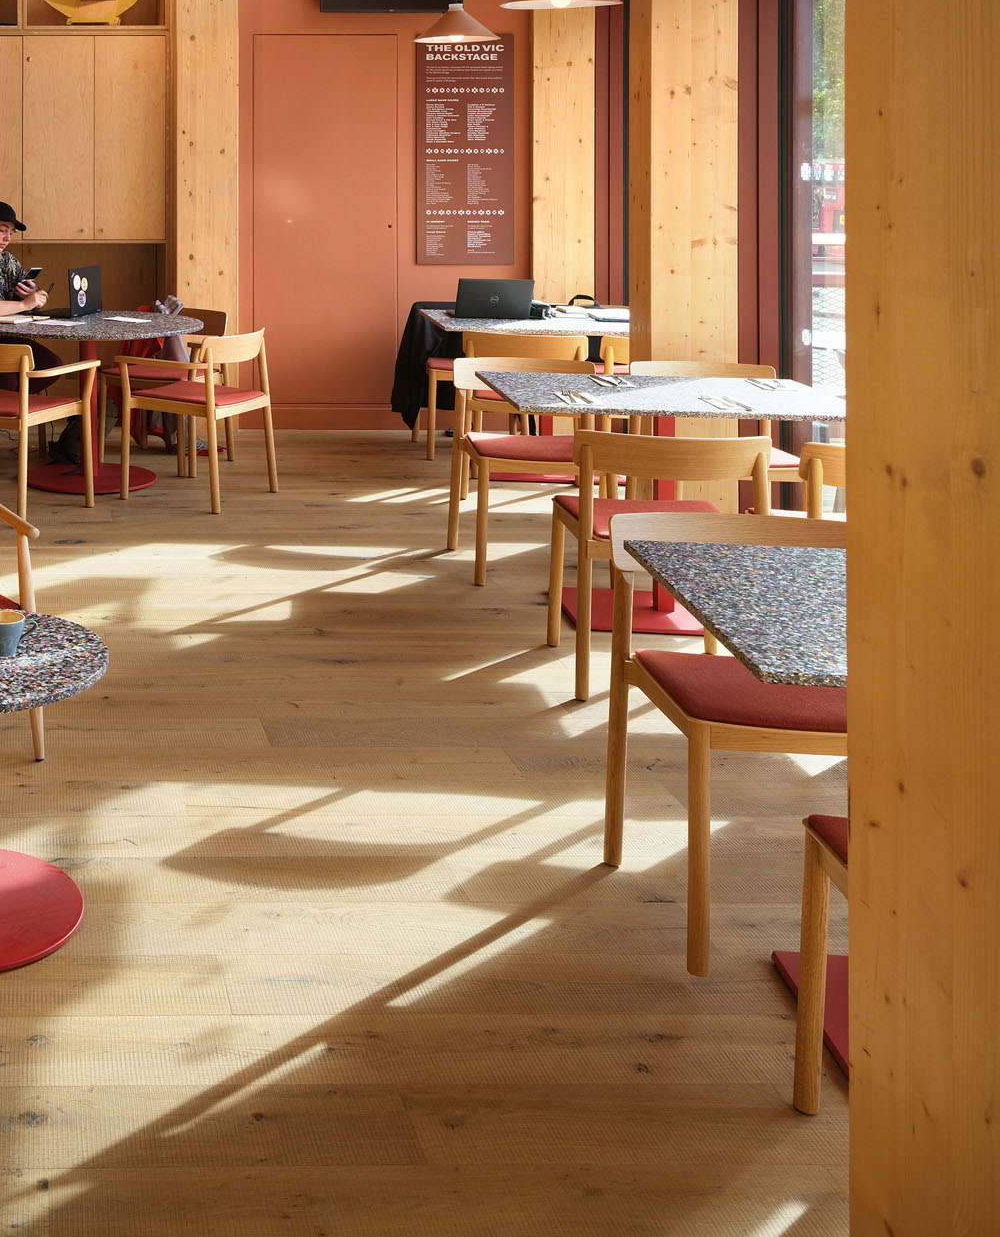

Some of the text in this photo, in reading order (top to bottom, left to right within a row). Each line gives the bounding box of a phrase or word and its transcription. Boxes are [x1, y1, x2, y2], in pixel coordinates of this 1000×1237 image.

[426, 44, 505, 52] THE OLD VIC
[425, 53, 499, 61] BACKSTAGE
